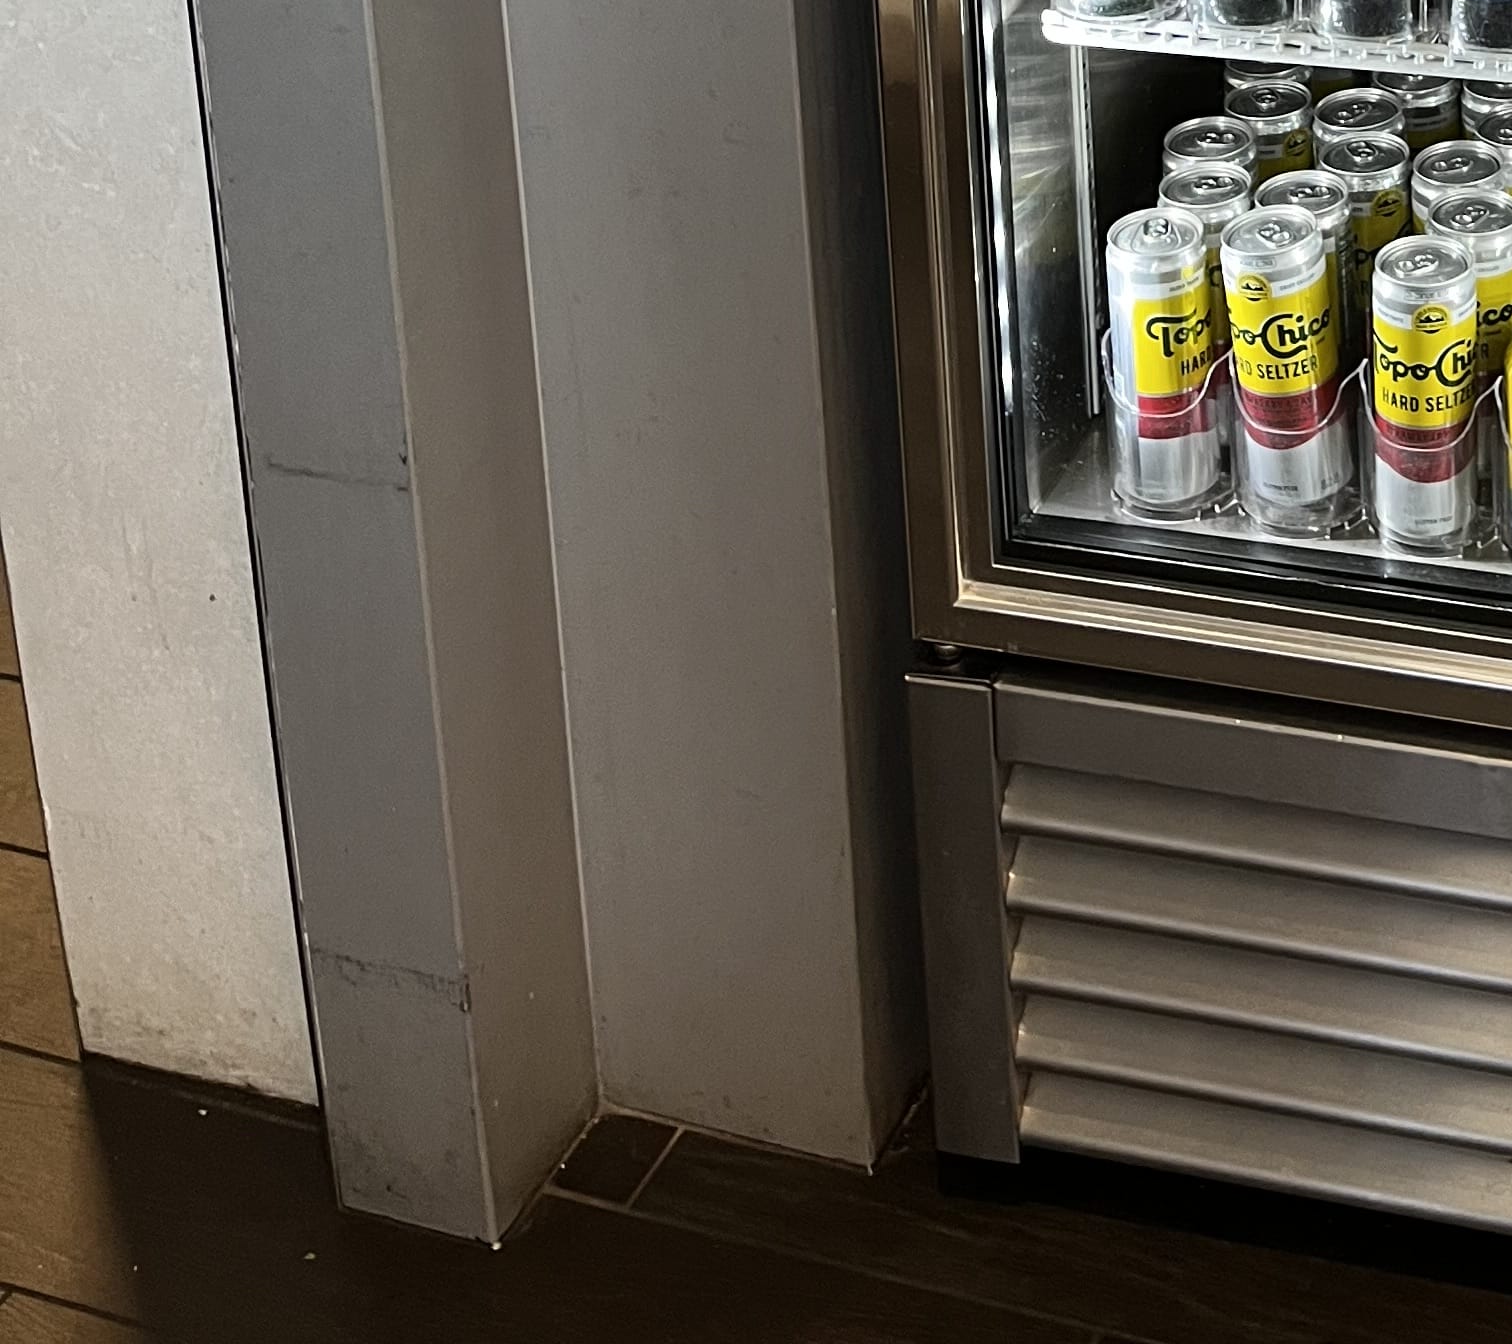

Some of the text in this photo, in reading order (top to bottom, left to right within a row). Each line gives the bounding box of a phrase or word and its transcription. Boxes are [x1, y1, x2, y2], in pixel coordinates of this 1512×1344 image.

[1146, 306, 1211, 358] Topo
[1256, 355, 1319, 381] SELTZER
[1381, 386, 1420, 412] HARD
